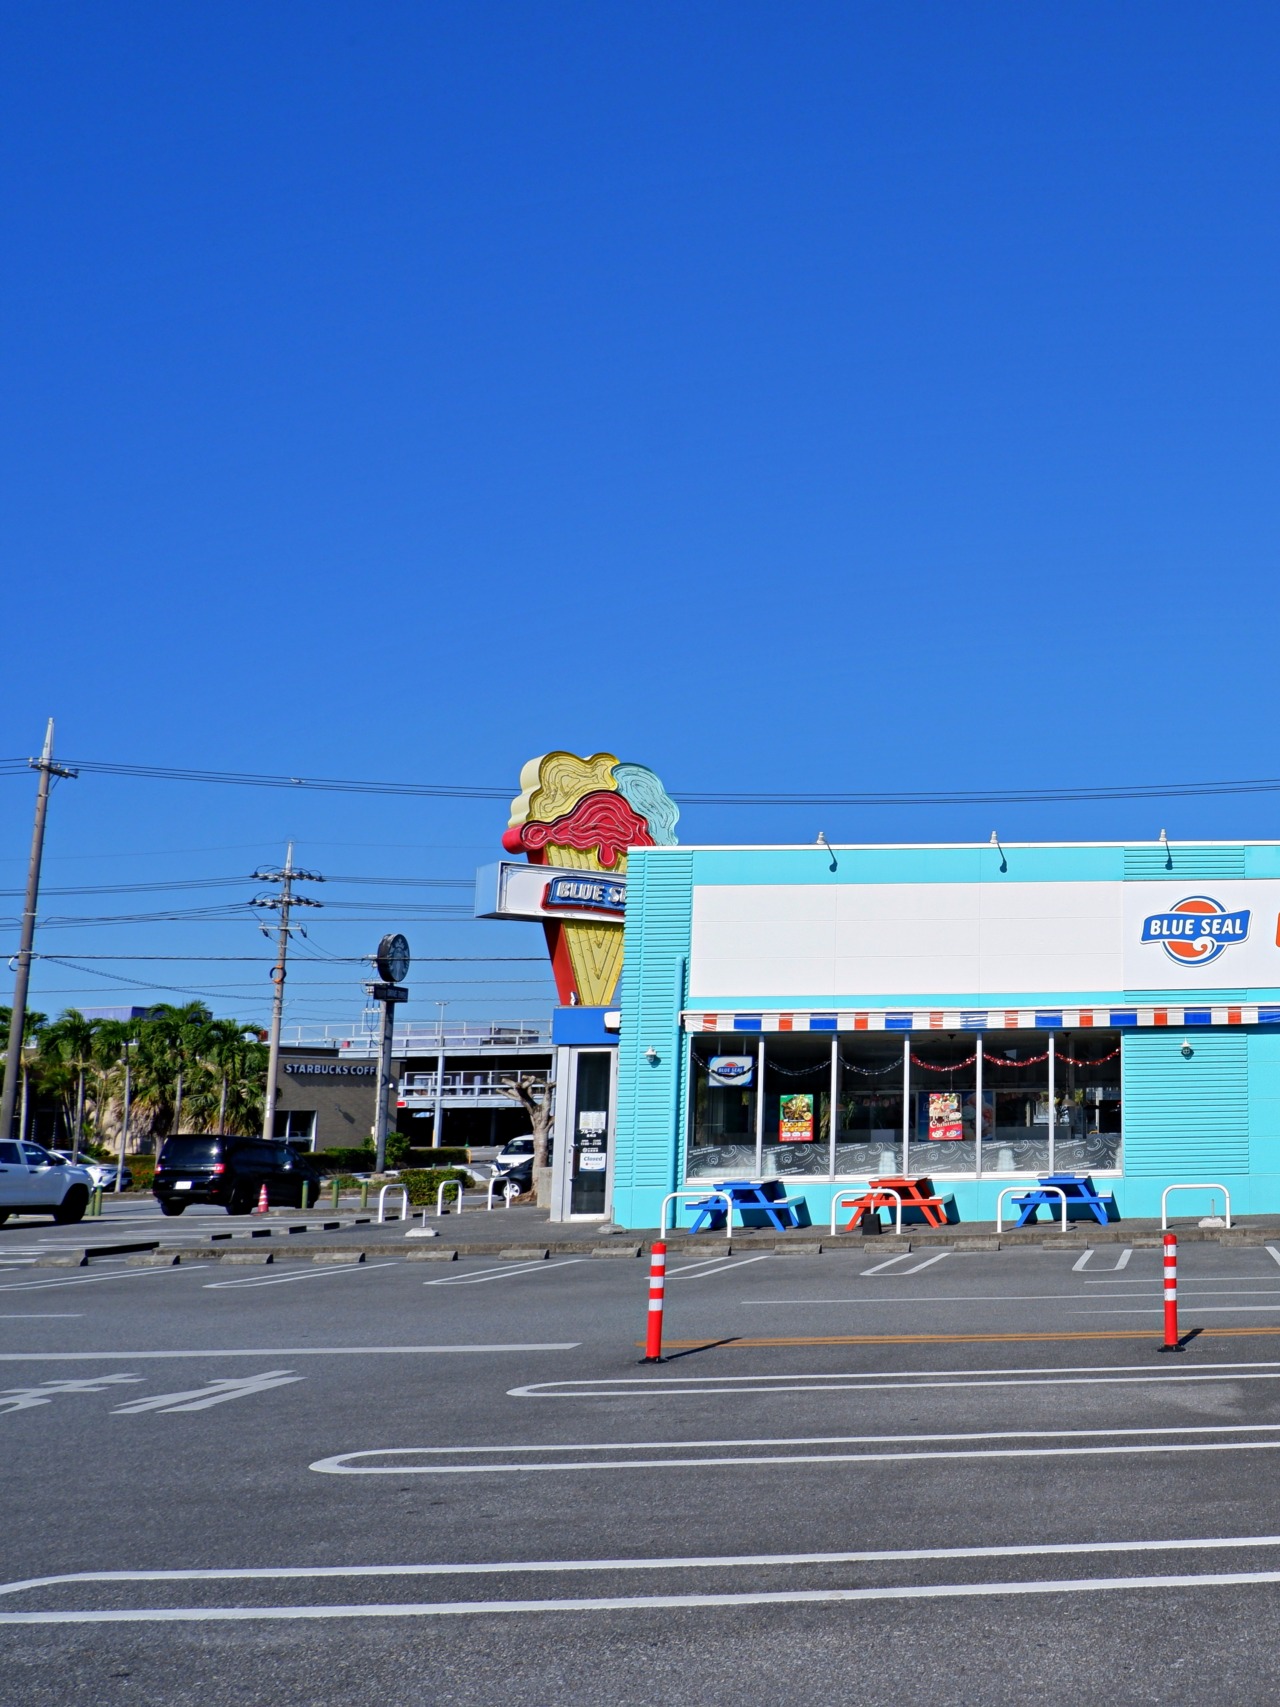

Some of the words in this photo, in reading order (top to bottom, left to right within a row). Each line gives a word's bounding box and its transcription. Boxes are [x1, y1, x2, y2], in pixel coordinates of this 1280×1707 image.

[557, 881, 604, 901] BLUE
[1150, 919, 1195, 935] BLUE
[1200, 918, 1243, 935] SEAL
[285, 1063, 349, 1075] STARBUCKS
[350, 1065, 380, 1076] COFF
